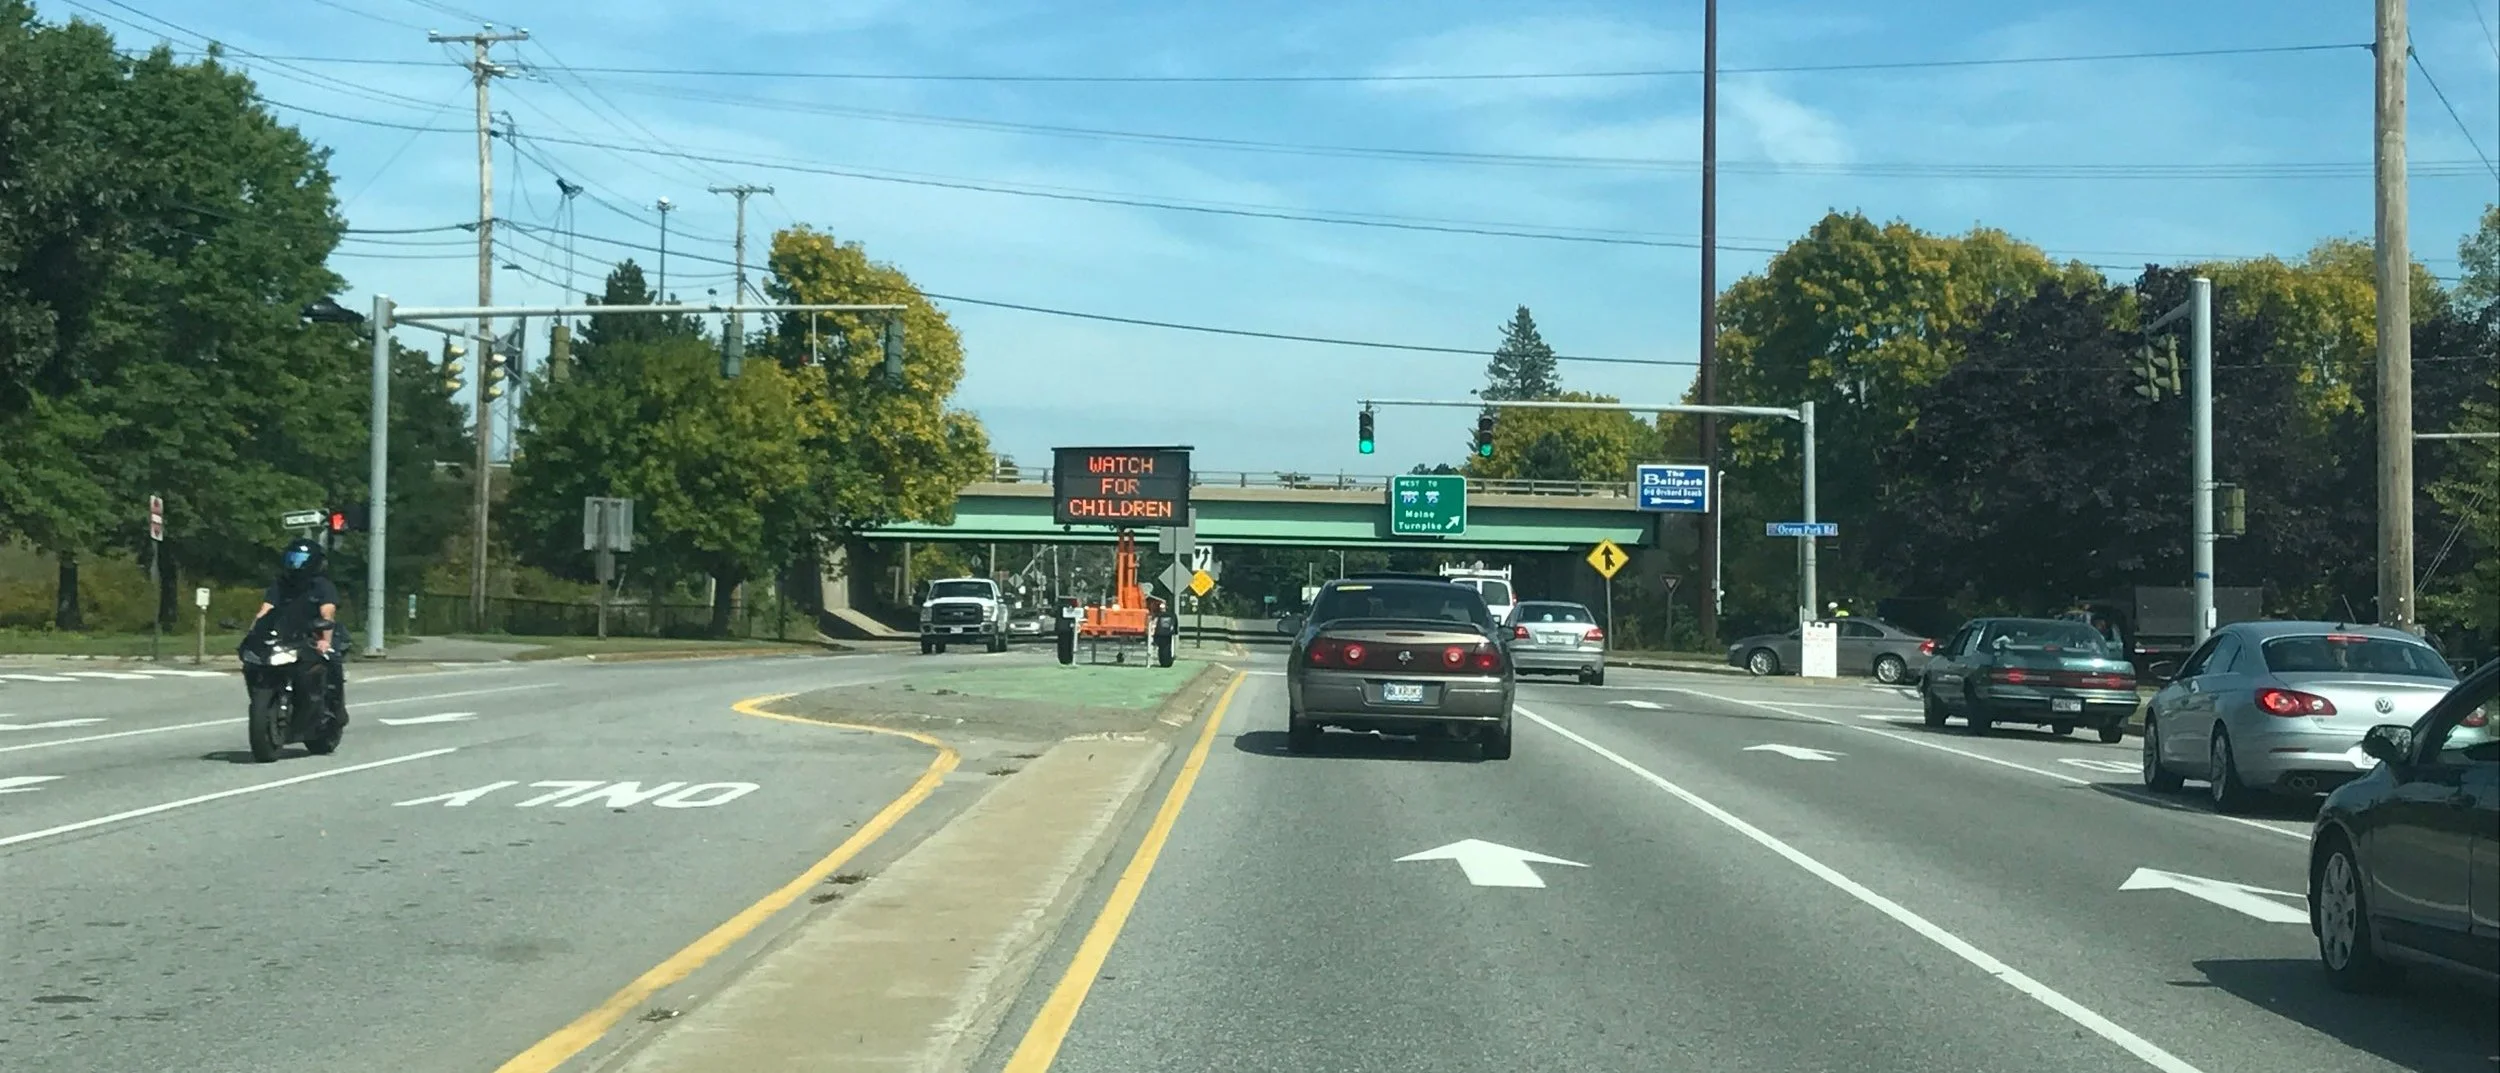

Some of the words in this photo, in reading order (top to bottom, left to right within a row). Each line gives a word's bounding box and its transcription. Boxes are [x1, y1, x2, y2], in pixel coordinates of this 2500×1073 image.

[1089, 456, 1153, 474] WATCH
[1643, 473, 1703, 487] Ballpark
[1665, 470, 1685, 478] The
[1101, 478, 1140, 495] FOR
[1427, 480, 1438, 488] TO
[1069, 499, 1171, 518] CHILDREN
[1405, 510, 1435, 519] Maine
[1398, 521, 1442, 531] Turnpike
[391, 780, 761, 808] ONLY
